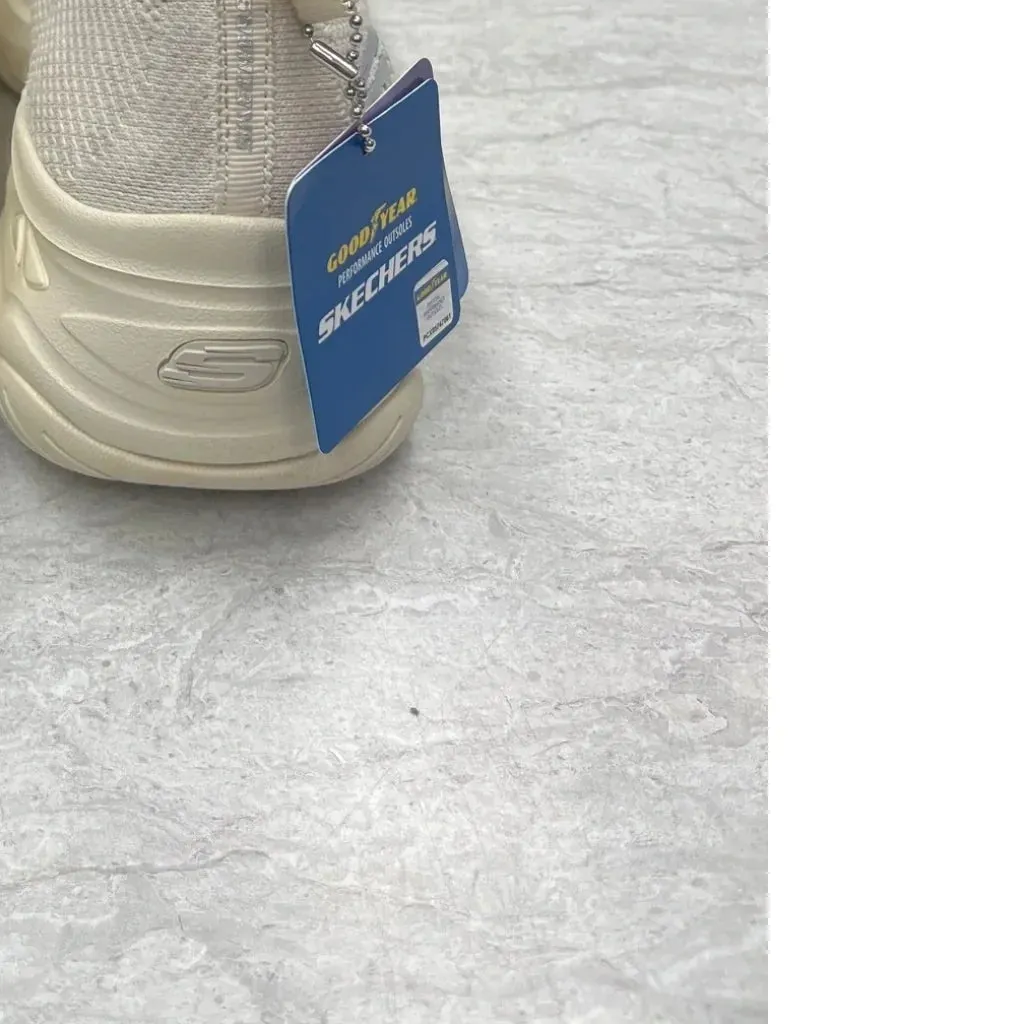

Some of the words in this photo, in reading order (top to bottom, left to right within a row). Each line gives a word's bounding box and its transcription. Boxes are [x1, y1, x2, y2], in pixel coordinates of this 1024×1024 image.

[318, 220, 437, 344] SKECHERS
[338, 242, 382, 288] PERFORMANCE
[384, 216, 412, 248] OUTSOLES
